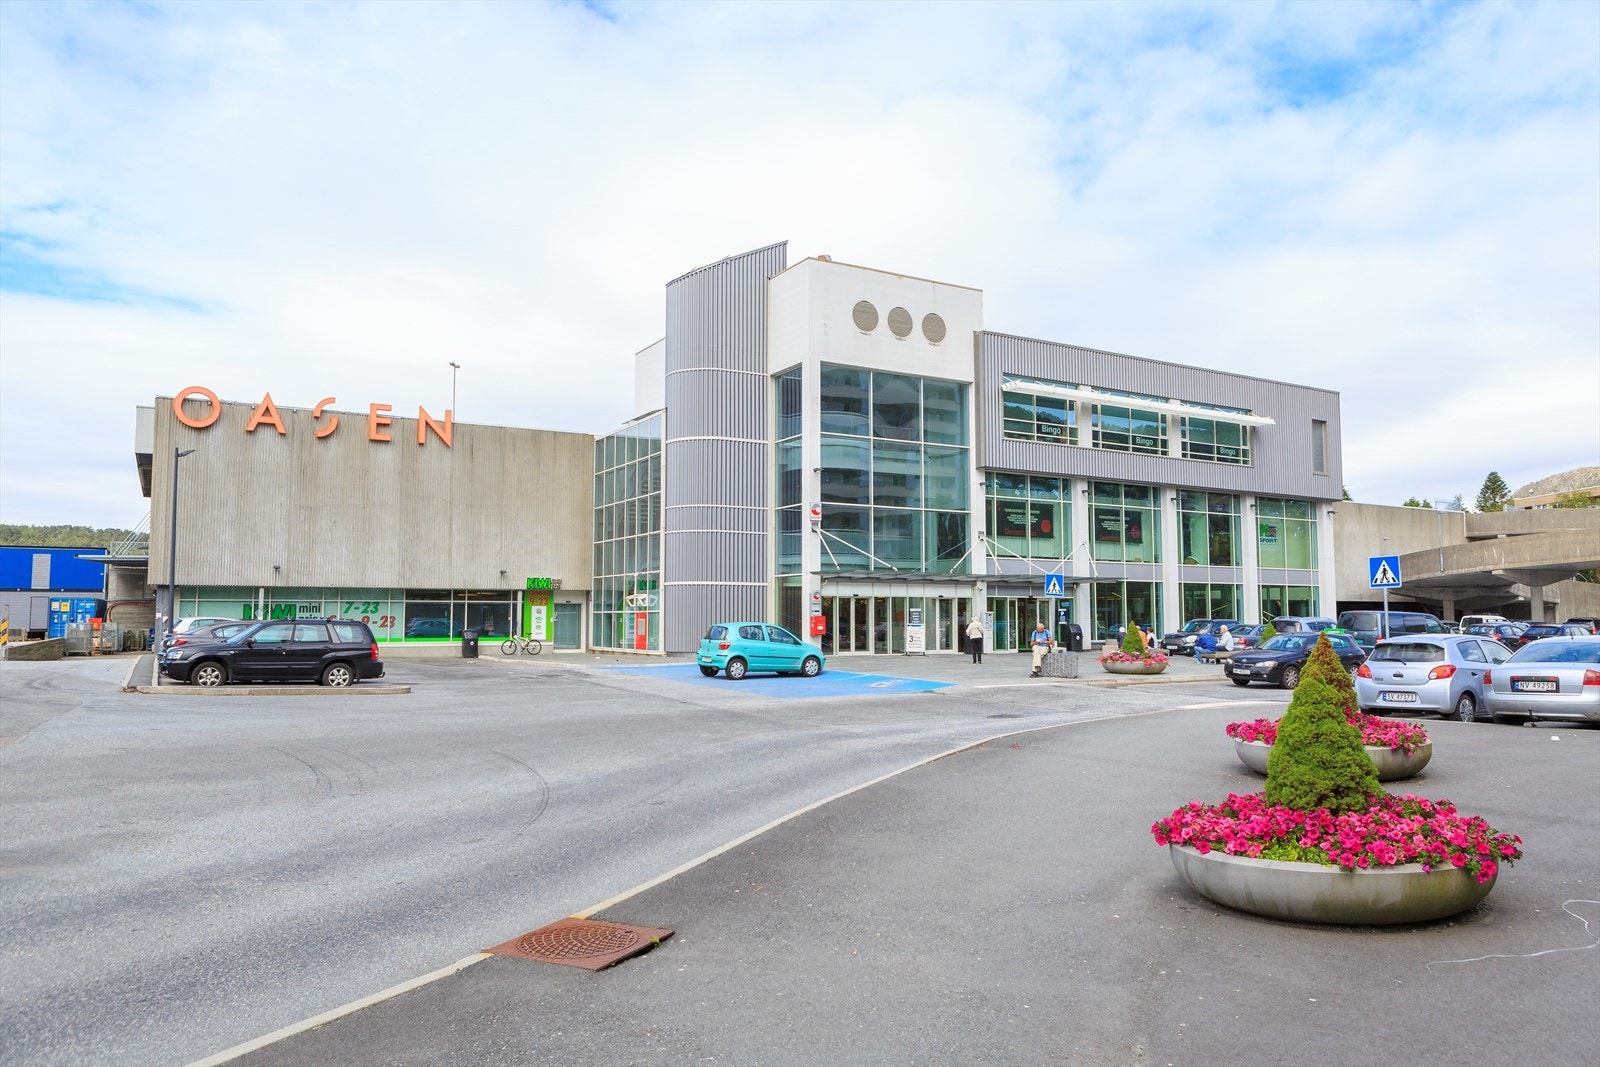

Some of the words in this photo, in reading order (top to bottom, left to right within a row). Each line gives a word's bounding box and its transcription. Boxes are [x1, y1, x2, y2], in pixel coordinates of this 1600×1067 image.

[173, 385, 453, 448] OASEN
[1041, 424, 1062, 435] Bingo
[1135, 436, 1154, 447] Bingo
[1219, 446, 1236, 457] Bingo
[527, 577, 552, 589] KIWI
[242, 603, 297, 620] KIWI
[298, 602, 321, 614] mini
[908, 635, 914, 643] 3
